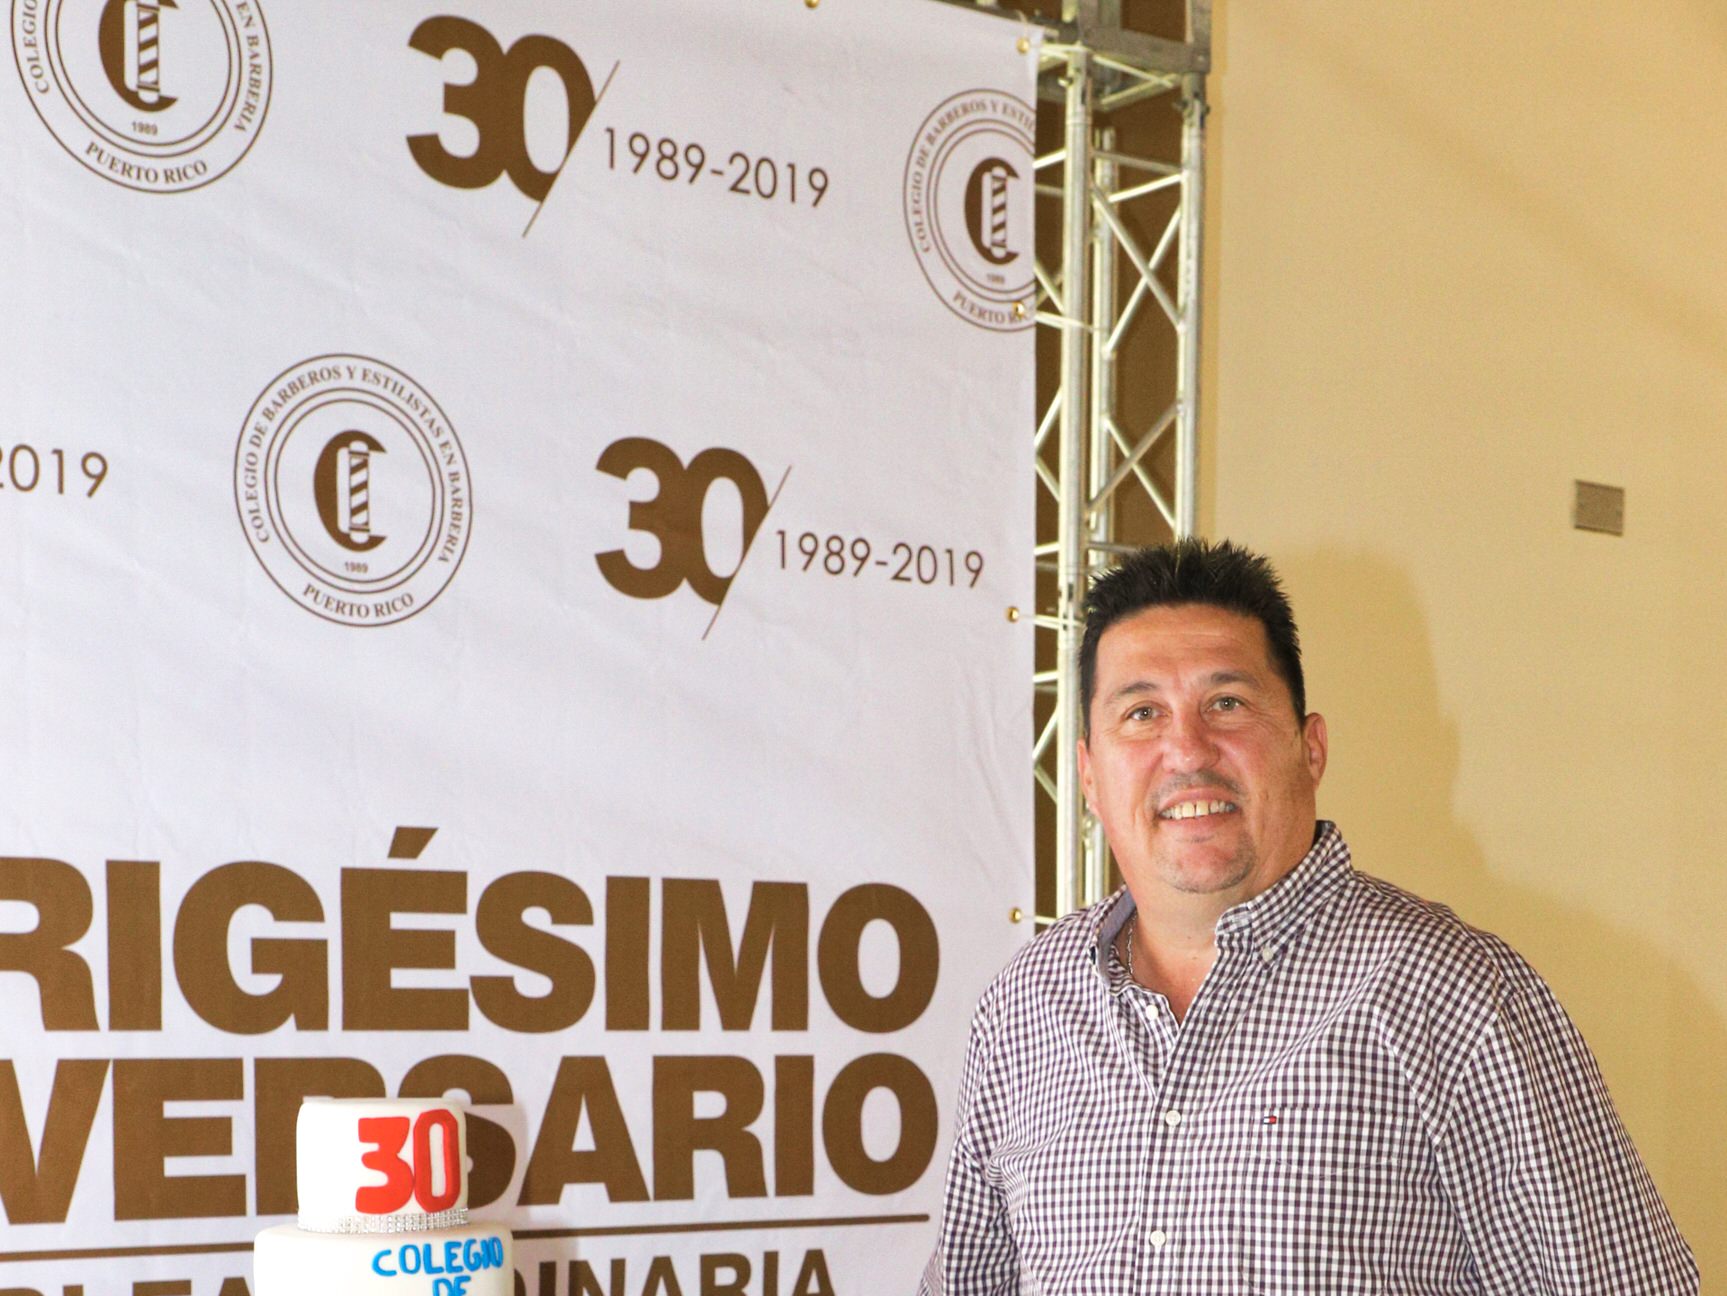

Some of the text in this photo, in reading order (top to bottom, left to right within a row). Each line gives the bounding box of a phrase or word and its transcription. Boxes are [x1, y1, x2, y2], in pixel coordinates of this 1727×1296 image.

[236, 1, 255, 28] EN
[23, 0, 49, 94] COLEGIO
[85, 141, 208, 185] PUERTO RICO
[605, 127, 829, 207] 1989-2019
[262, 365, 342, 422] BARBEROS
[345, 365, 358, 380] Y
[361, 367, 444, 439] ESTILISTAS
[249, 422, 268, 449] DE
[440, 437, 457, 466] EN
[0, 443, 108, 498] 019
[244, 452, 270, 544] COLEGIO
[776, 529, 984, 589] 1989-2019
[302, 583, 414, 618] PUERTO RICO
[0, 827, 941, 1036] RIGÉSIMO
[355, 1109, 461, 1214] 30
[372, 1236, 504, 1277] COLEGIO
